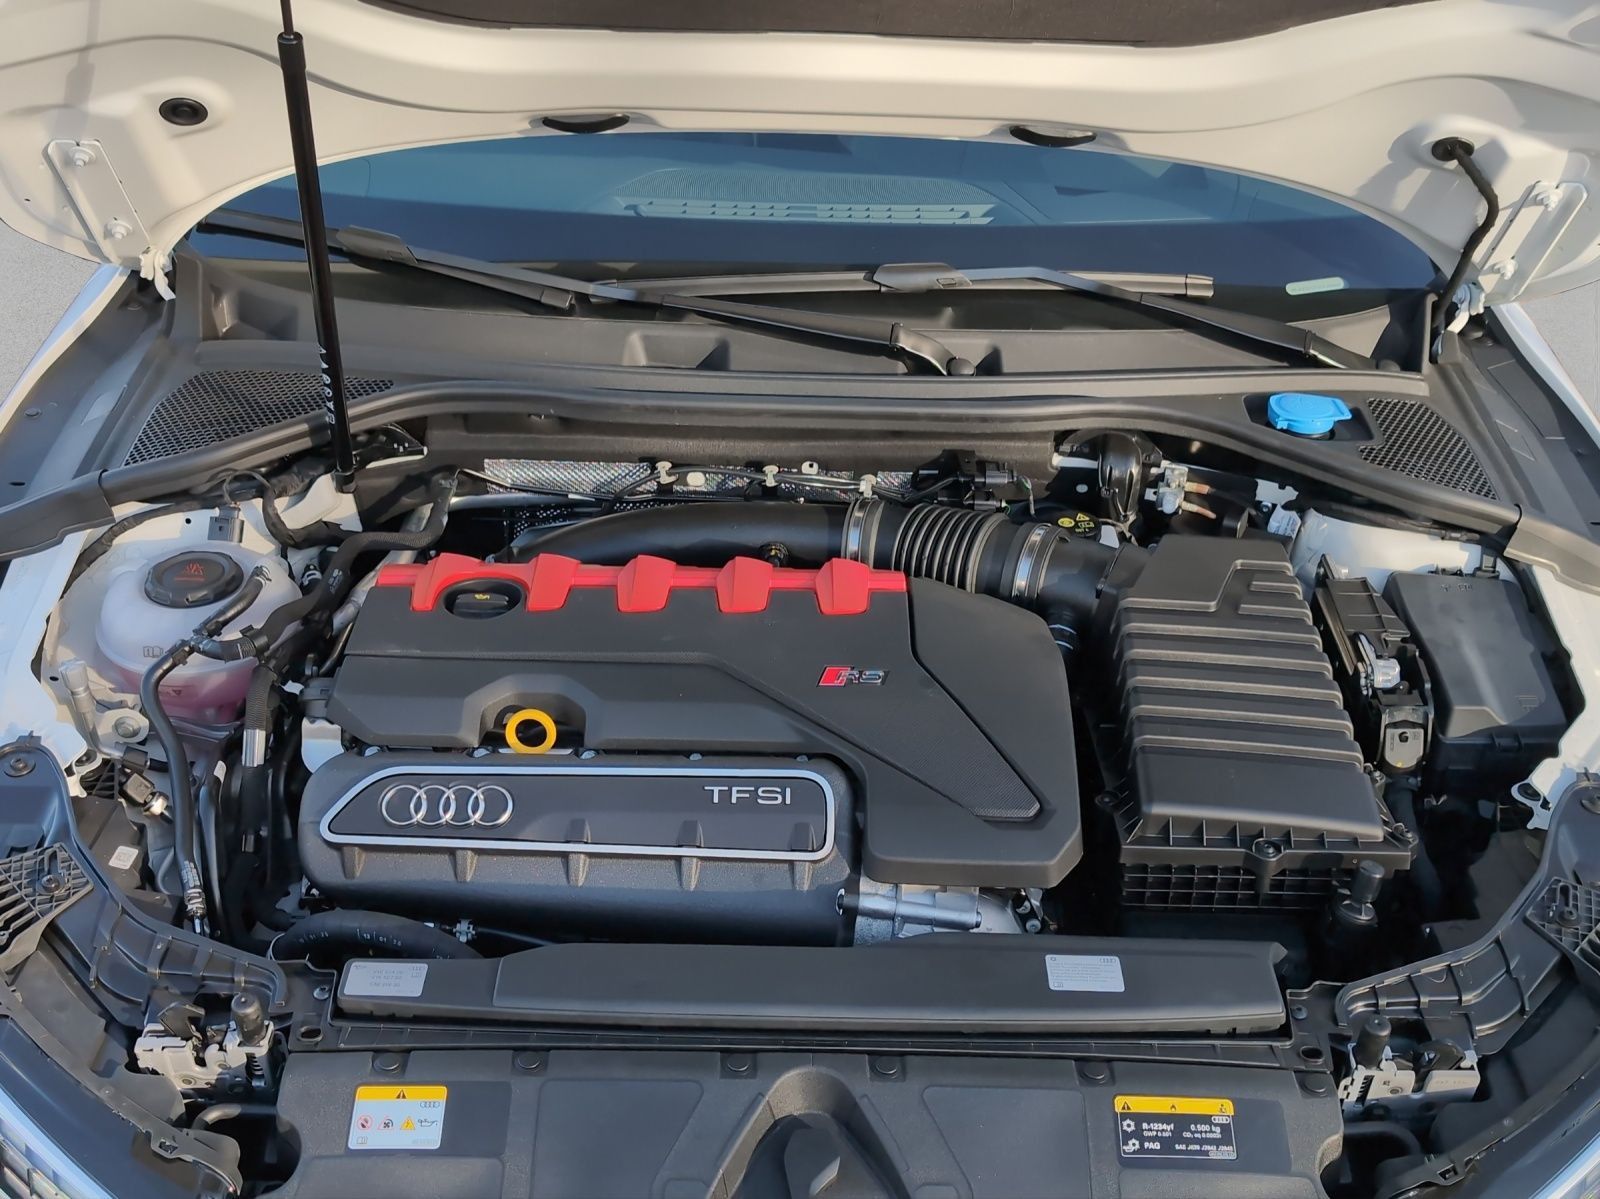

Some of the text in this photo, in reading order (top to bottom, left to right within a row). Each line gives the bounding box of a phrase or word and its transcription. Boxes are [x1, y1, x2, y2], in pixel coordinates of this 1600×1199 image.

[832, 669, 885, 686] RS
[704, 786, 791, 805] TFSI
[1211, 1124, 1221, 1133] kg
[1144, 1141, 1161, 1150] PAG
